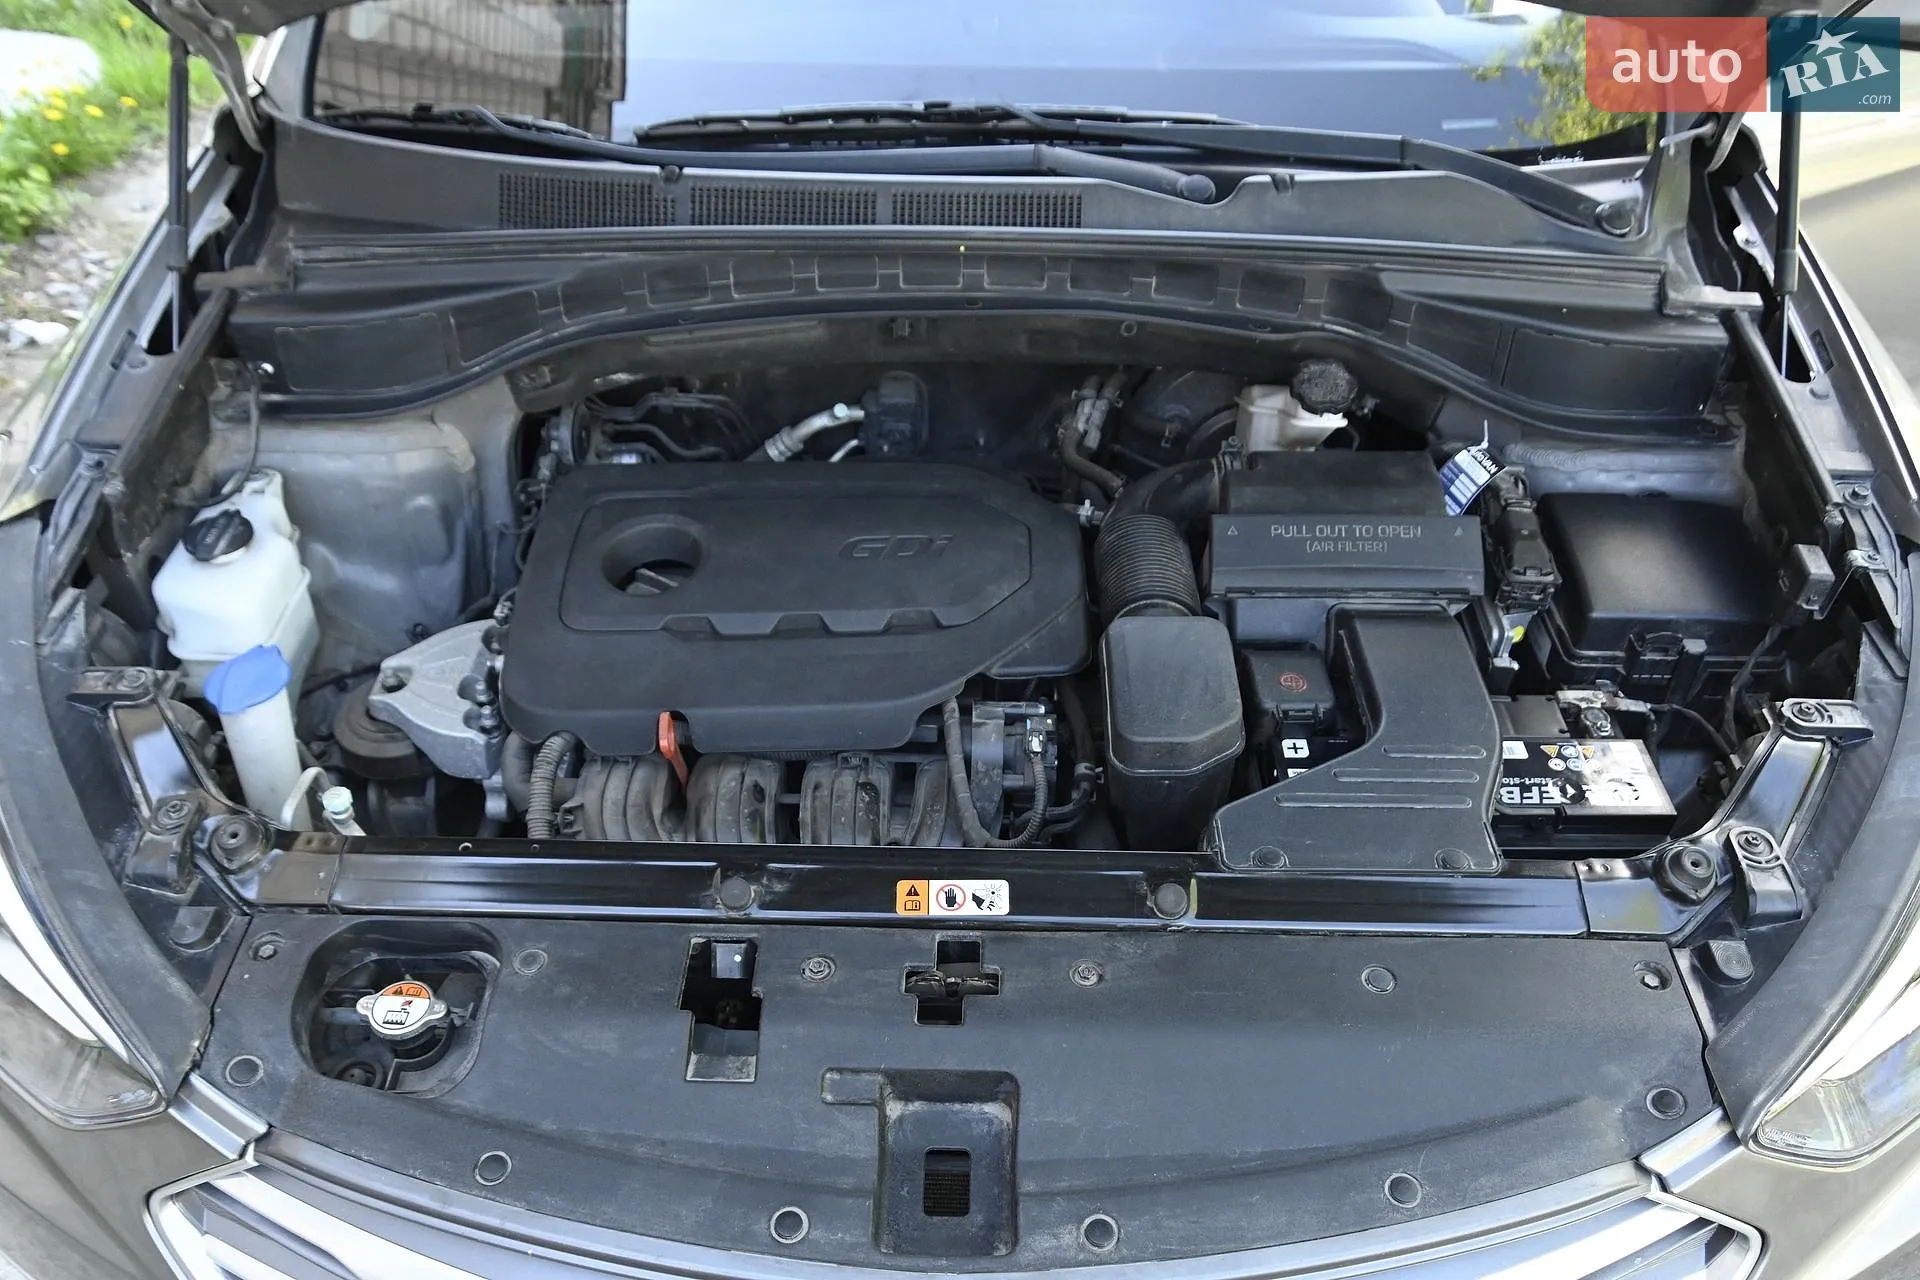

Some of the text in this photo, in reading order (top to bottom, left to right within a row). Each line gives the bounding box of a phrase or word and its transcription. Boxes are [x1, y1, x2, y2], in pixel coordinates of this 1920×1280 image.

[1271, 524, 1421, 539] PULL OUT TO OPEN
[1306, 540, 1388, 553] (AIR FILTER)
[1500, 786, 1562, 804] EFB
